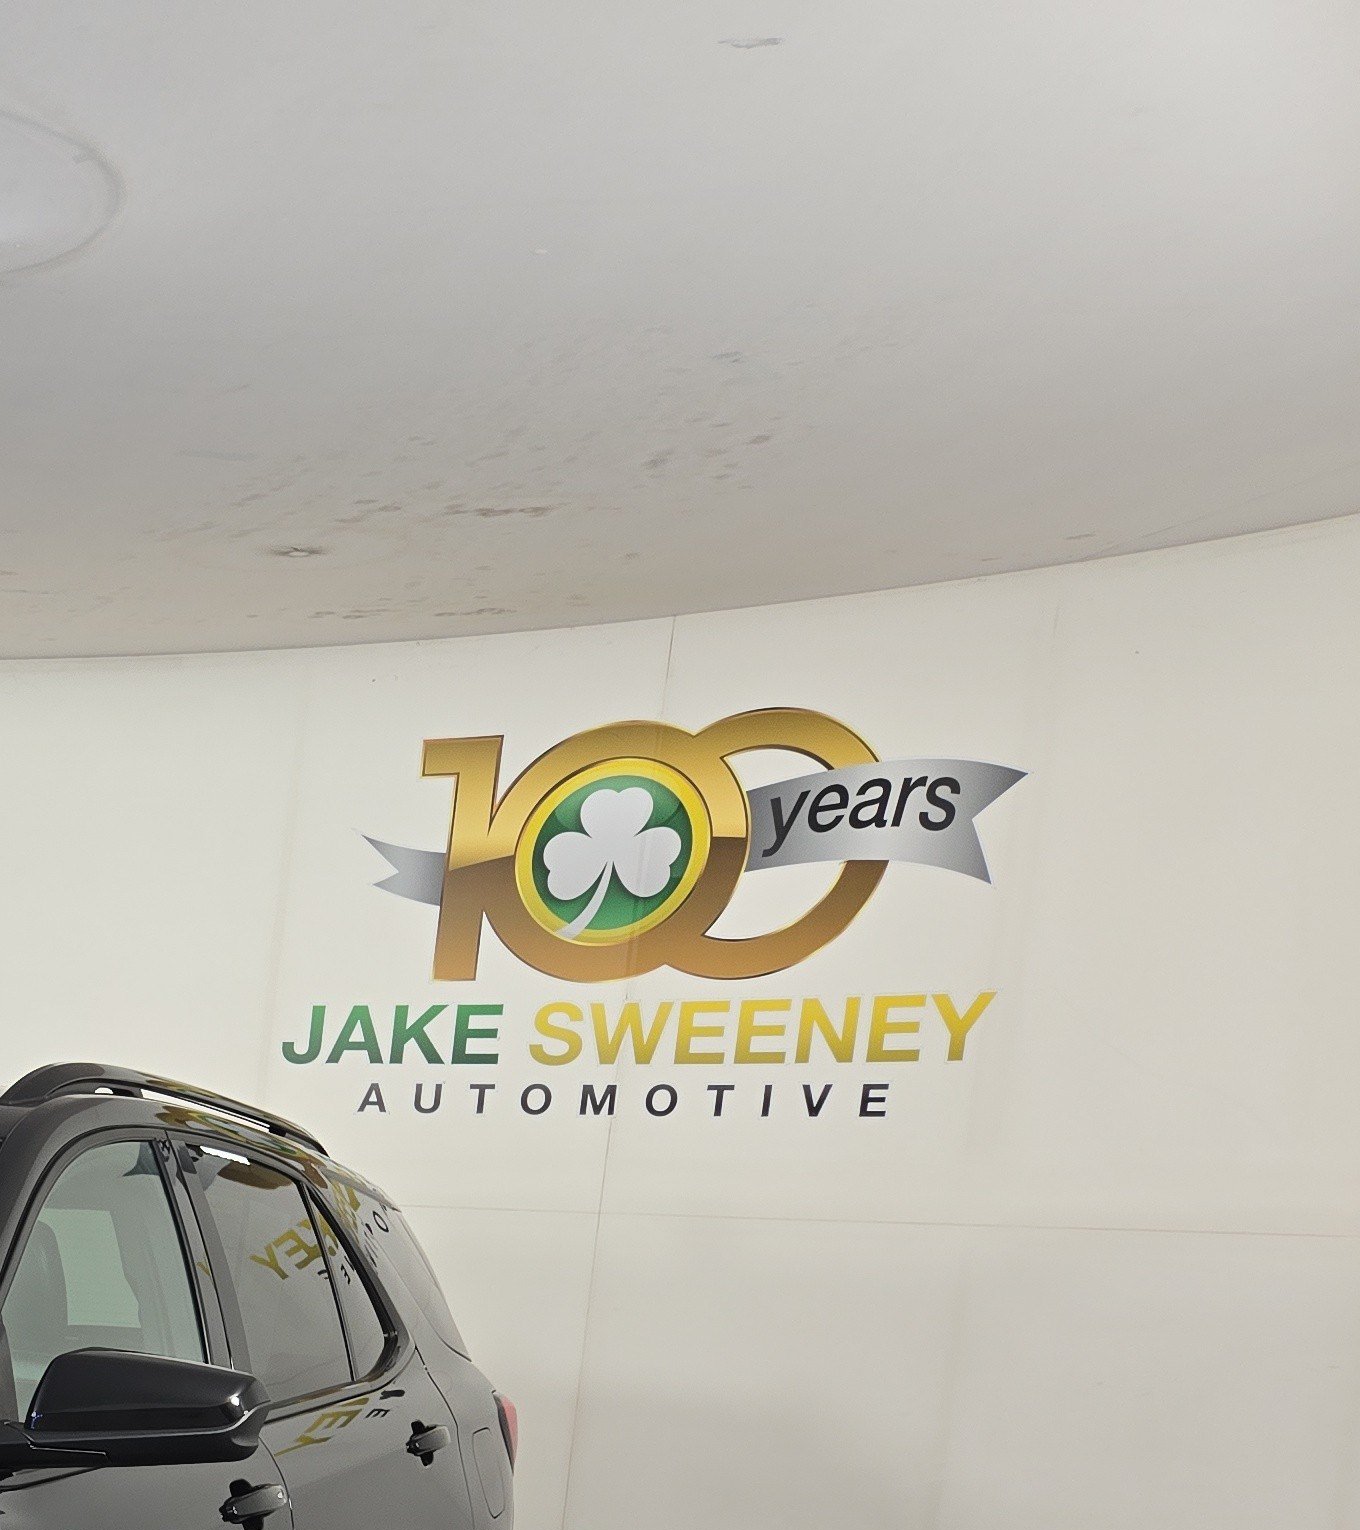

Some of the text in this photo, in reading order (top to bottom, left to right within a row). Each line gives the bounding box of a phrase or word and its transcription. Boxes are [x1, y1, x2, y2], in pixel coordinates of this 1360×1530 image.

[422, 707, 961, 982] 100 years
[281, 991, 998, 1067] JAKE SWEENEY
[358, 1082, 890, 1119] AUTOMOTIVE
